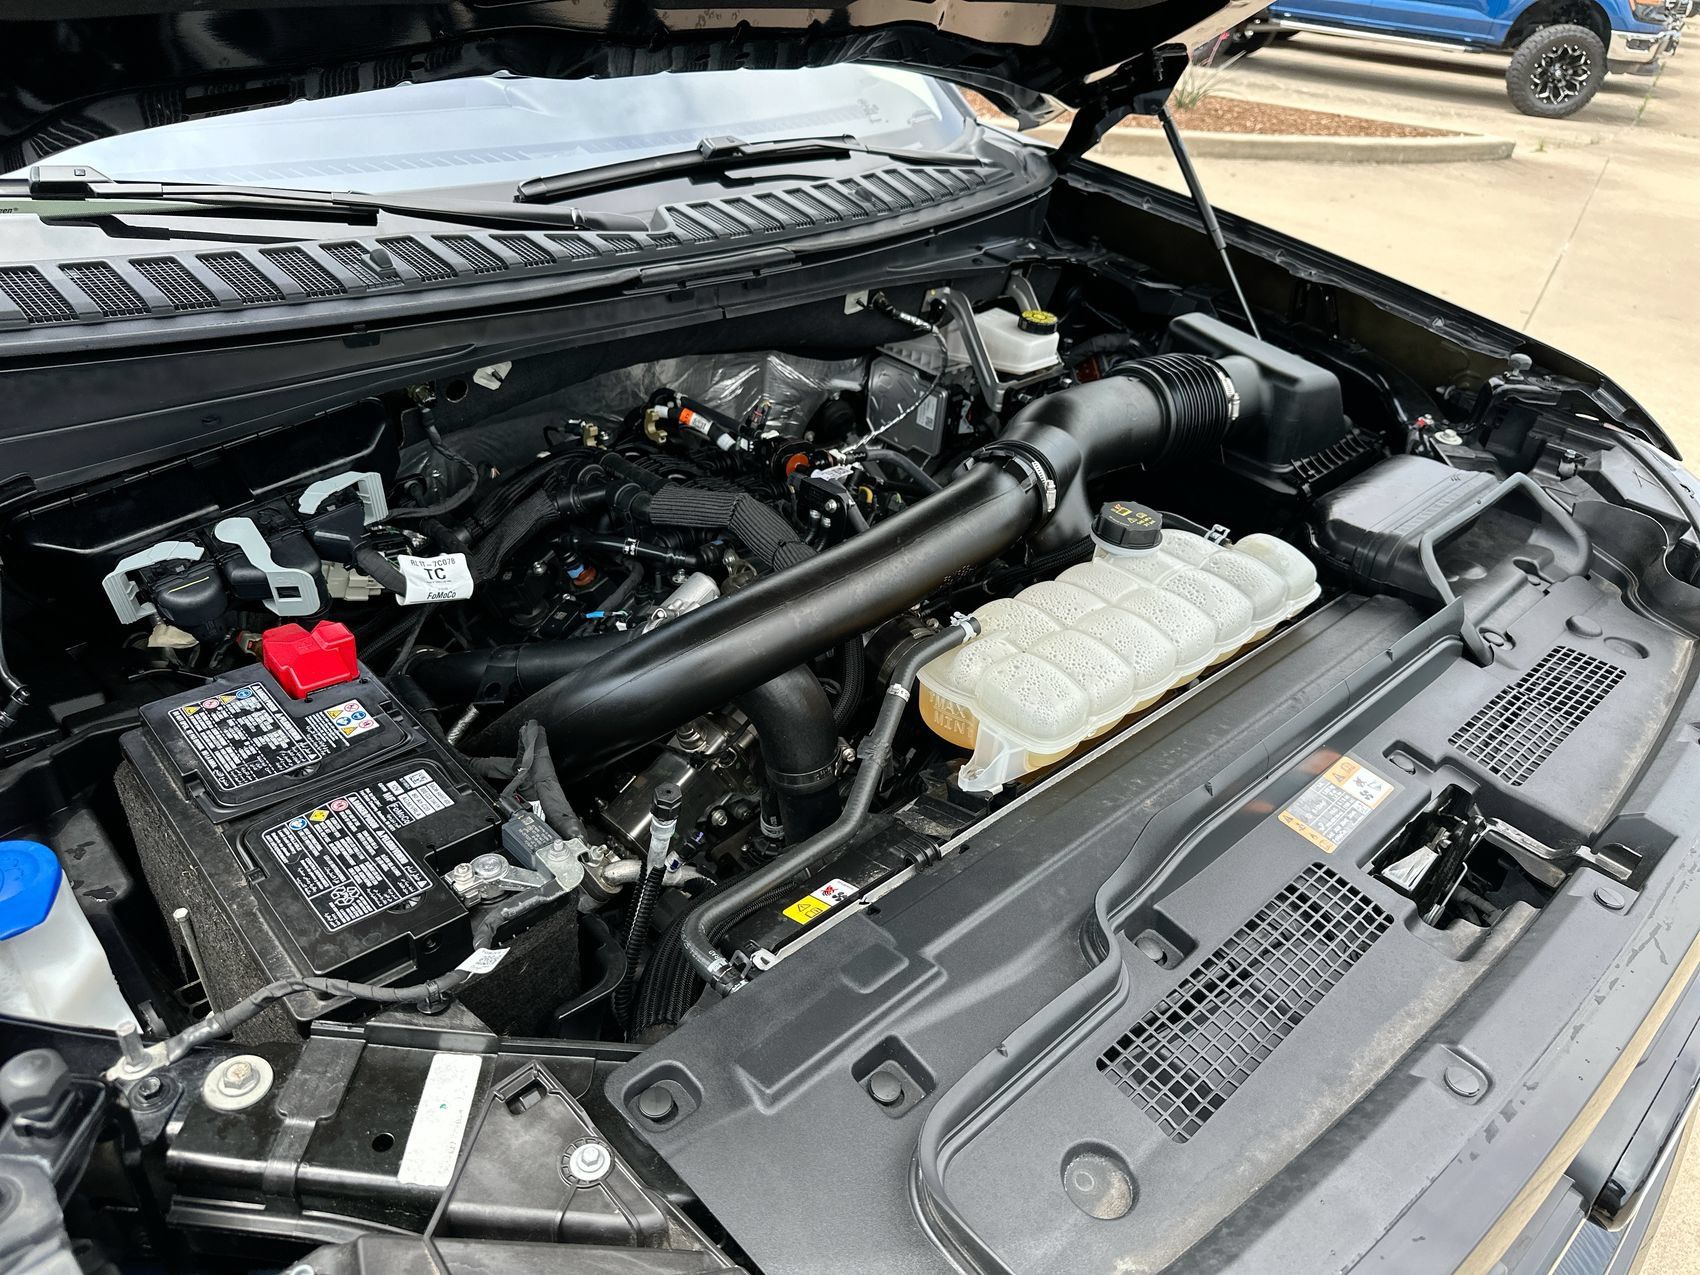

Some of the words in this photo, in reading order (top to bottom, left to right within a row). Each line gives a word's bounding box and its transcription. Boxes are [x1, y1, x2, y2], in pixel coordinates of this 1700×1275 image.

[424, 567, 446, 580] TC
[427, 591, 456, 599] FoMoCo
[933, 696, 966, 719] MAX
[934, 711, 966, 735] MIN
[391, 802, 410, 825] FoMoCo
